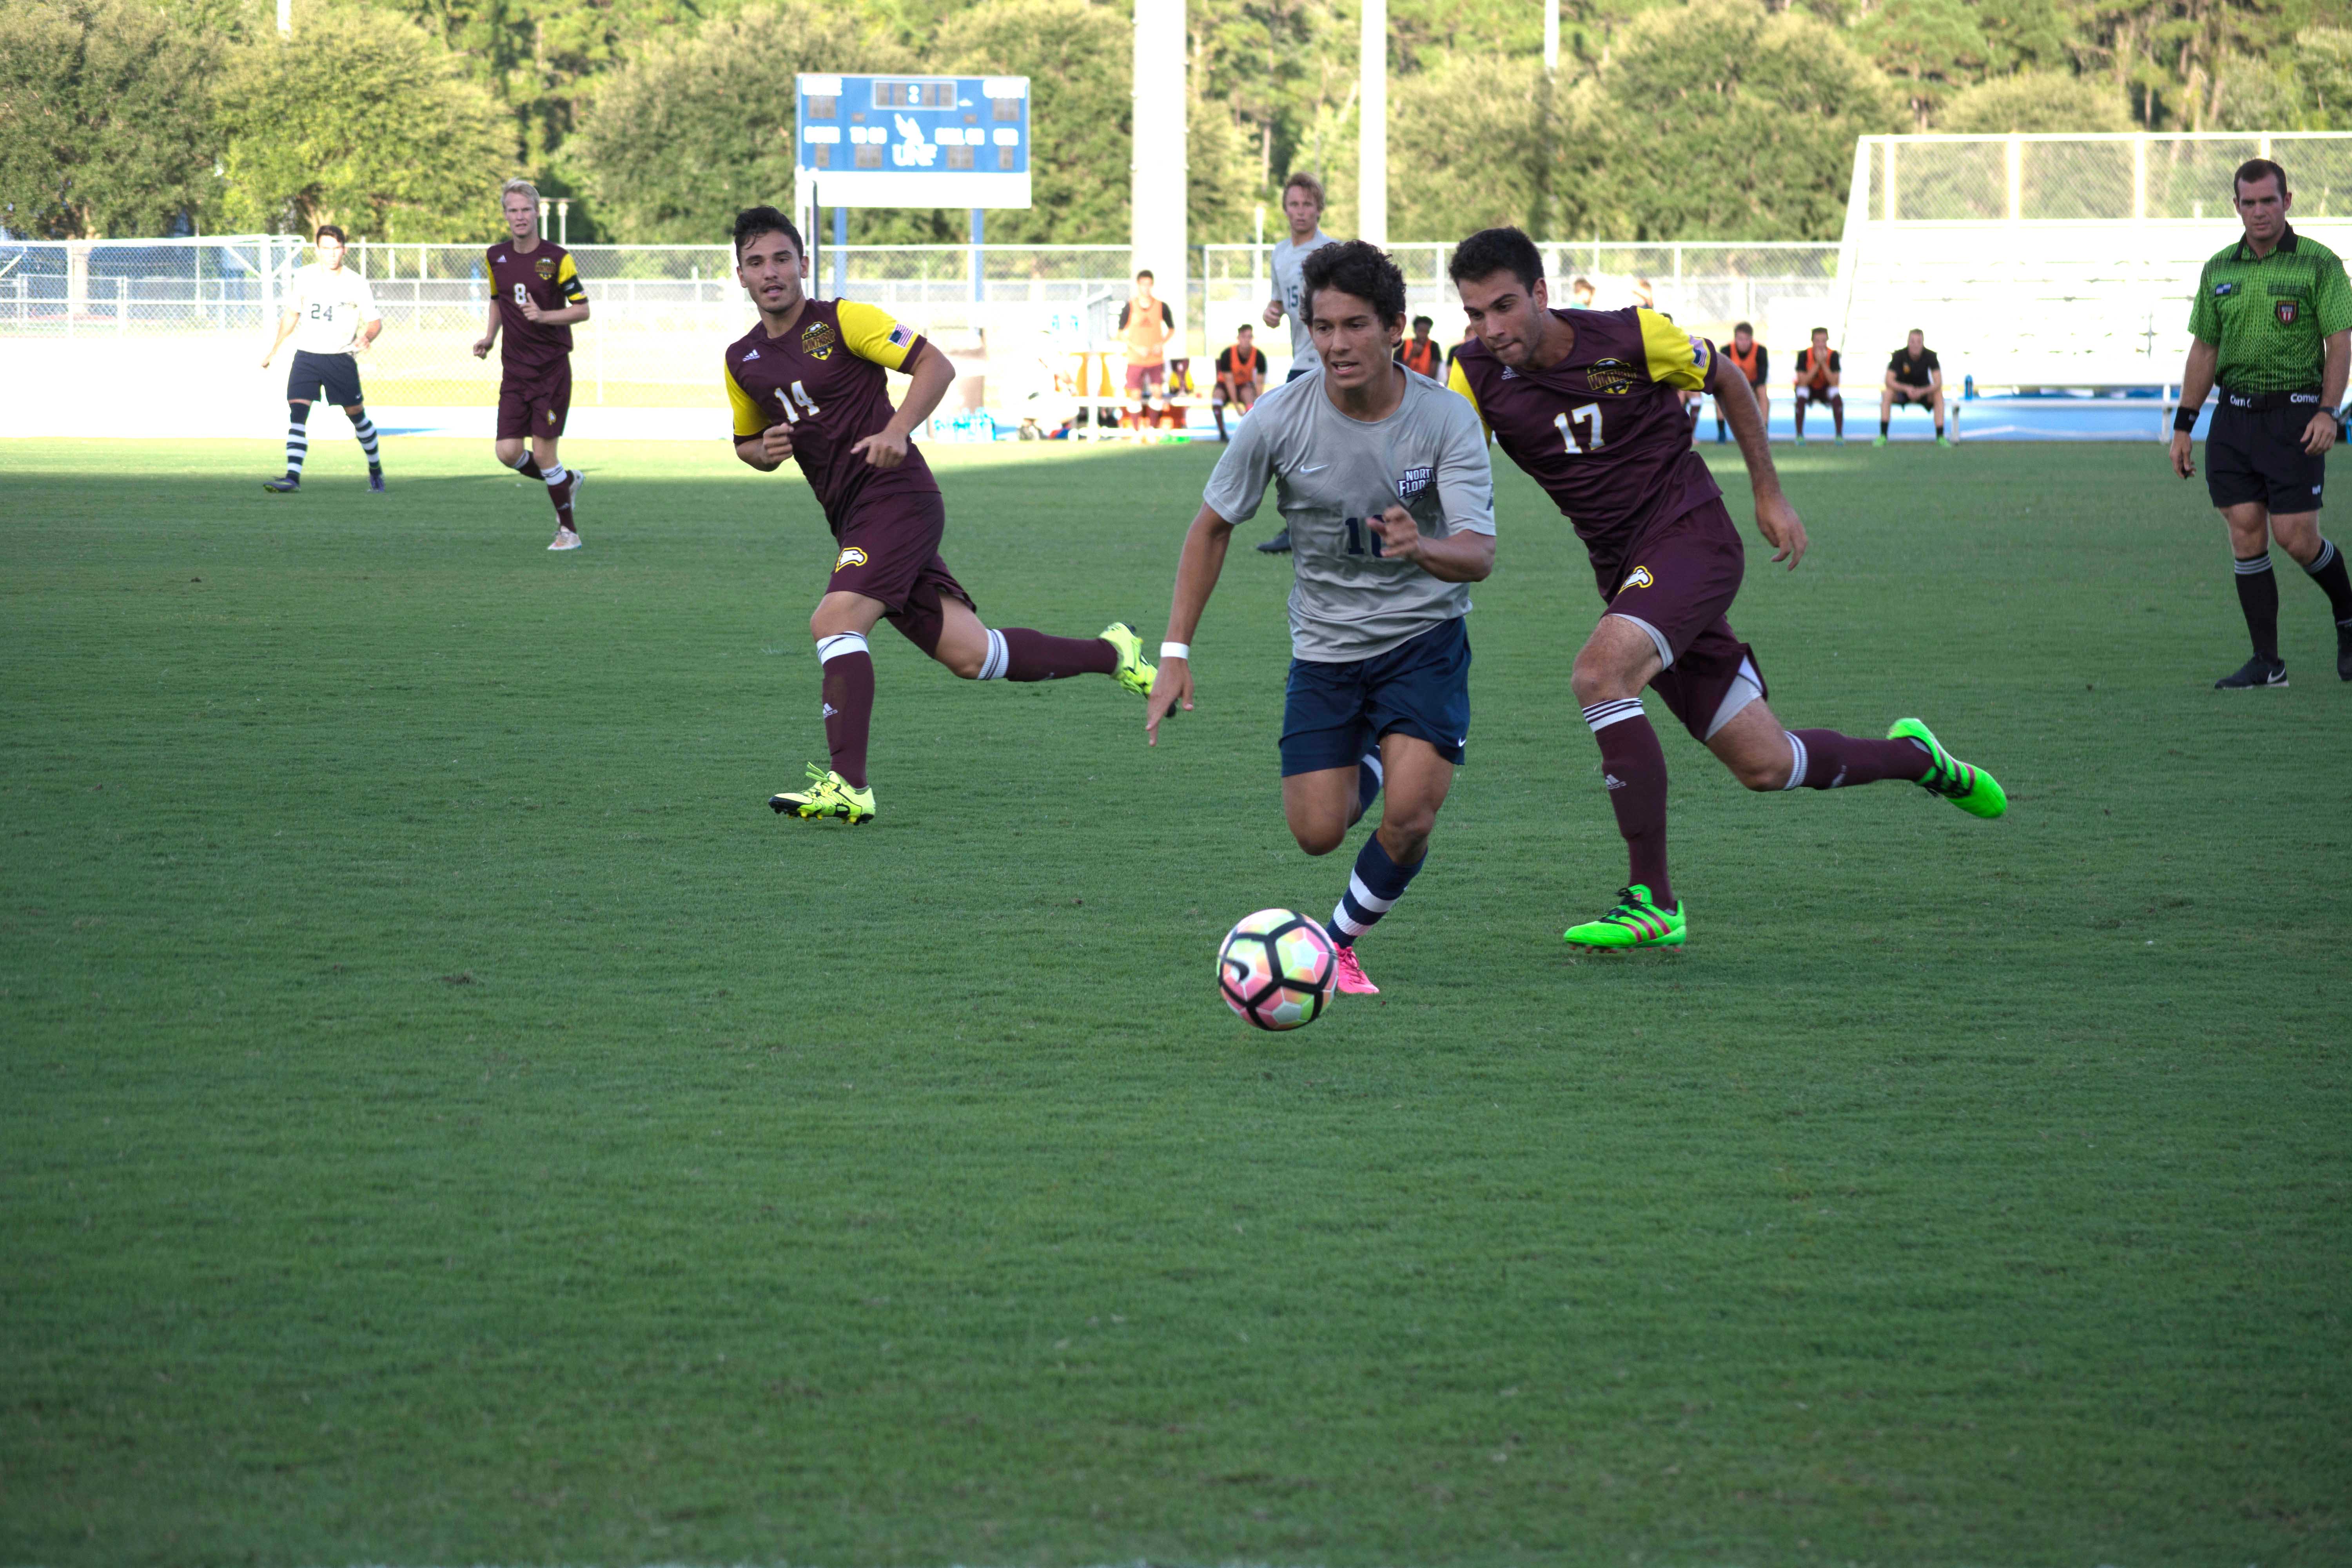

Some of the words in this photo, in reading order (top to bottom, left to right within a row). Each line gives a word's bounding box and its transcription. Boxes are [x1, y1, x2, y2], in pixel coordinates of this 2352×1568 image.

[514, 282, 526, 305] 8
[1287, 285, 1299, 309] 15
[311, 303, 333, 321] 24
[774, 380, 820, 424] 14
[1553, 402, 1606, 454] 17
